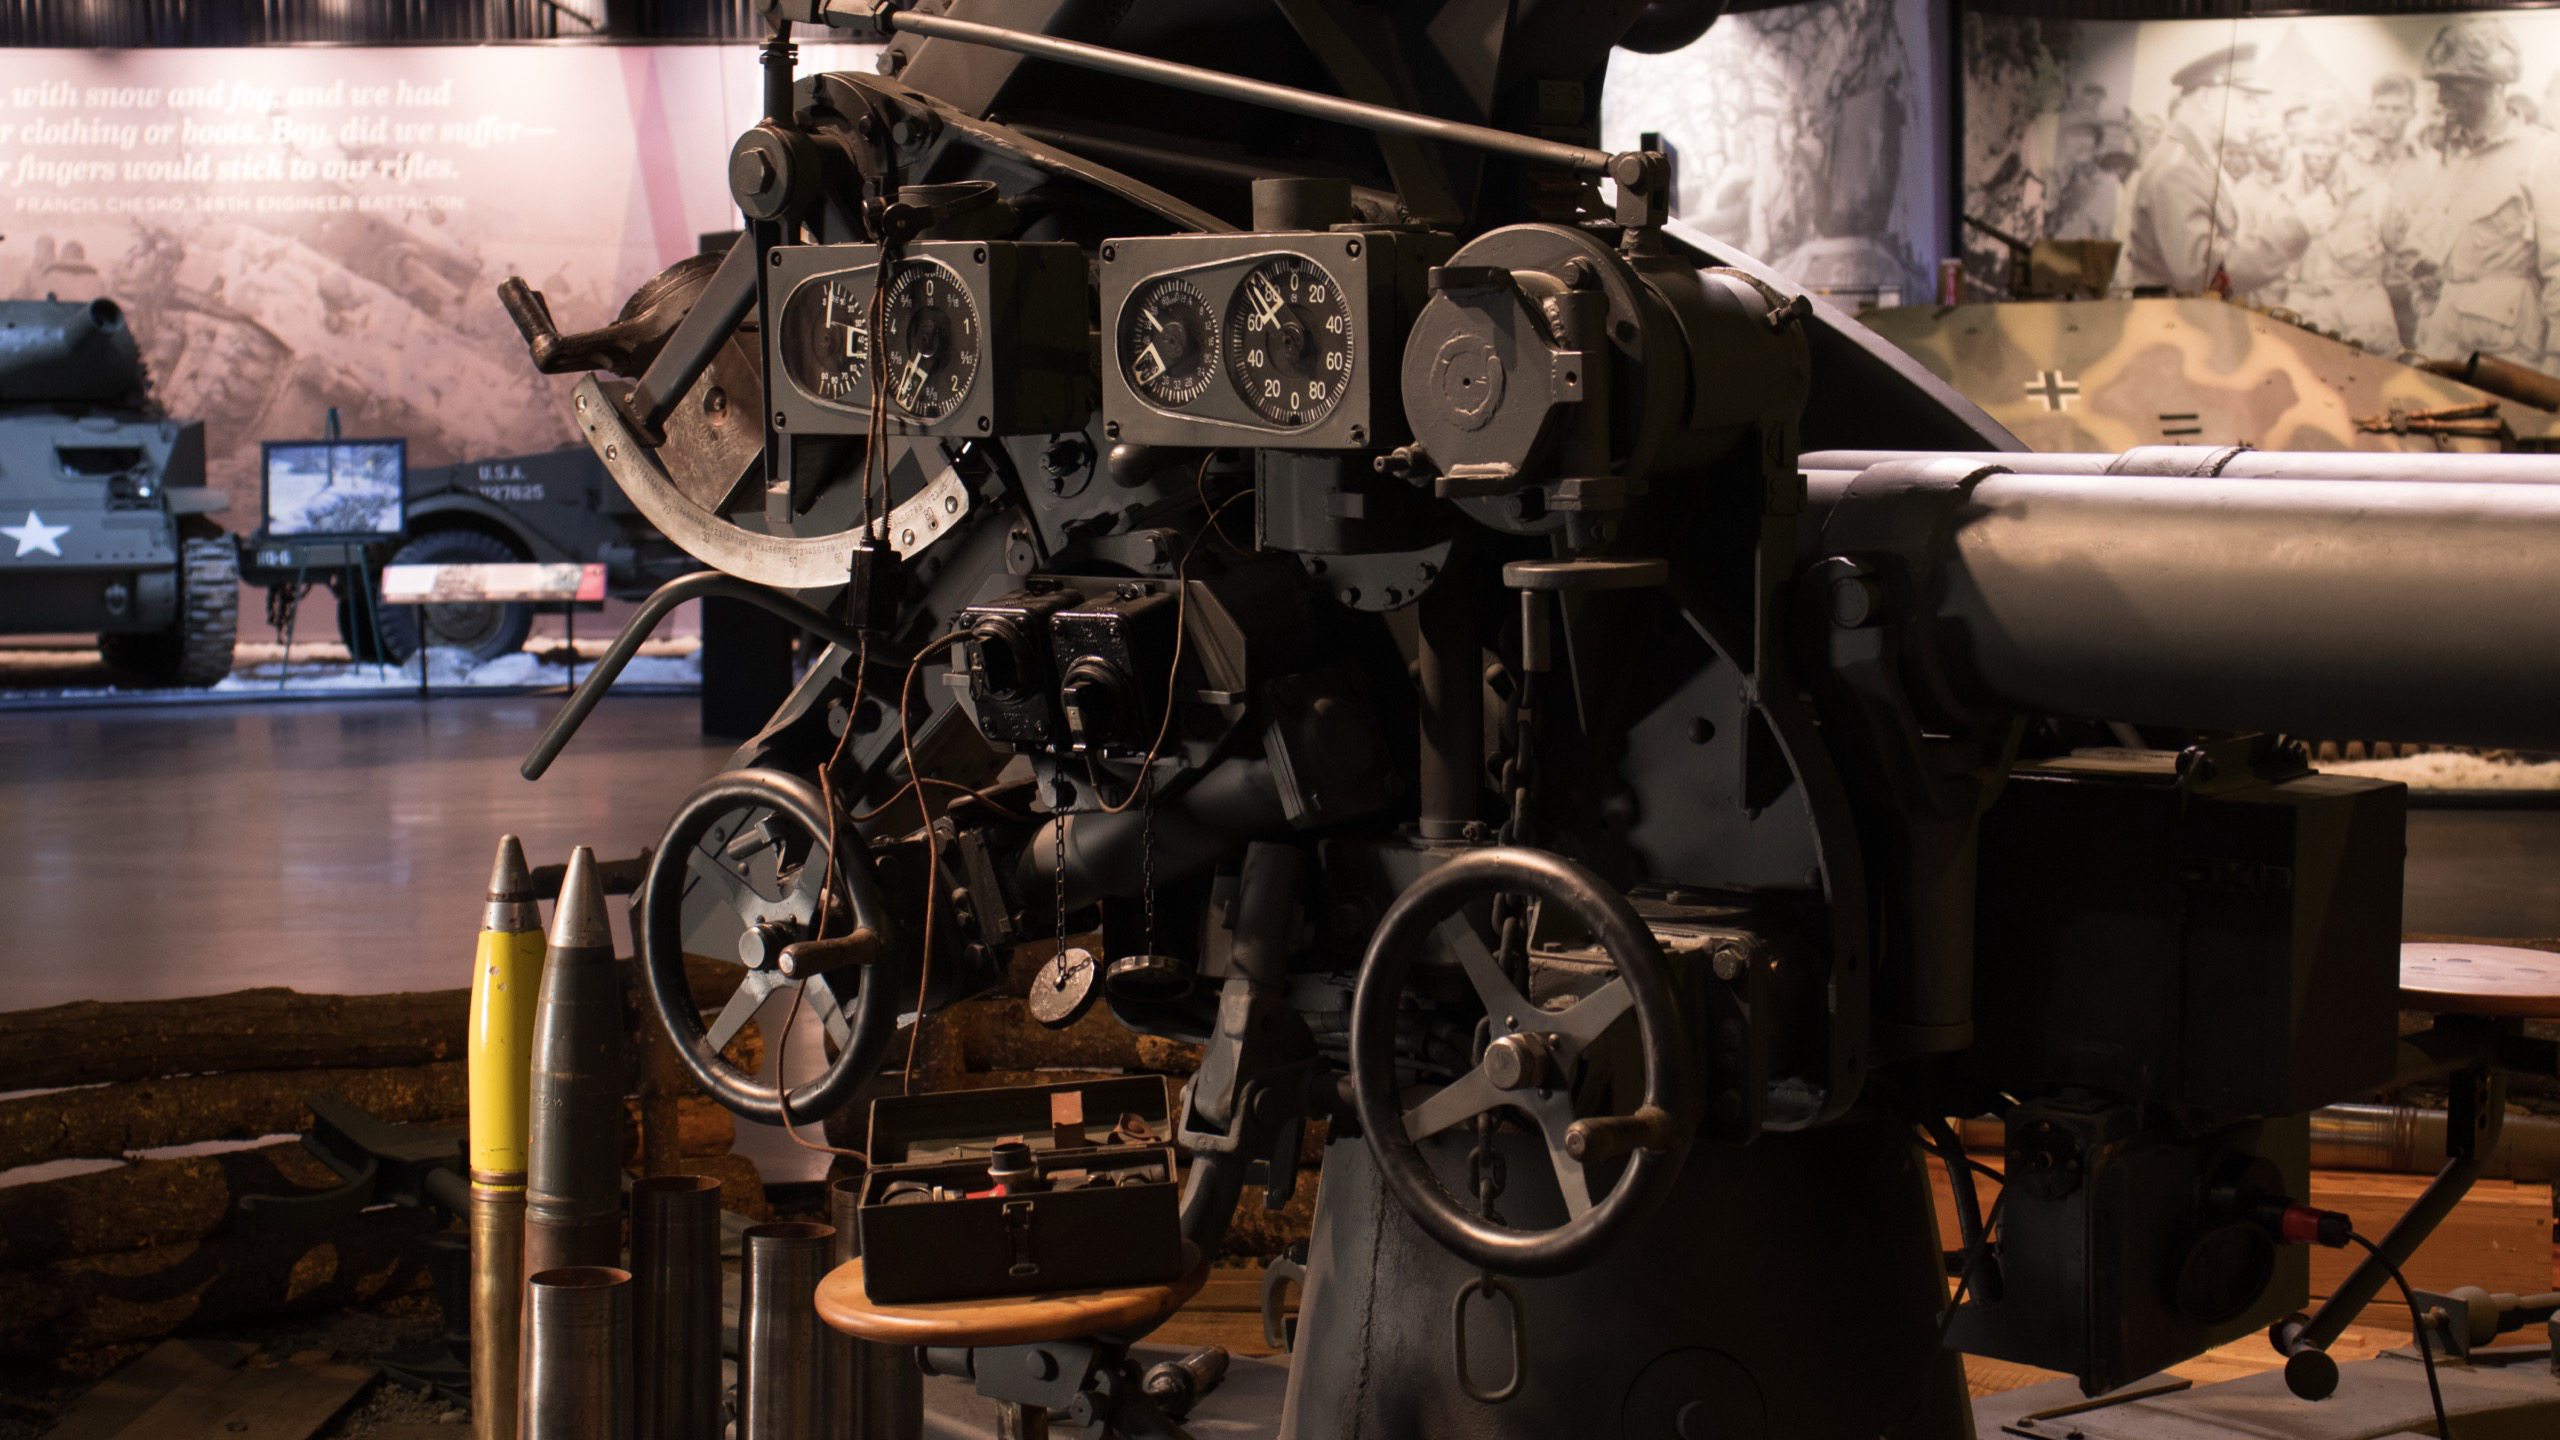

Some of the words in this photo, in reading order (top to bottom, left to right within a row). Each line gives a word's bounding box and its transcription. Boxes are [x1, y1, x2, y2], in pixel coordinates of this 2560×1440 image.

[11, 80, 78, 109] with
[85, 87, 162, 108] snow
[168, 80, 225, 108] and
[287, 80, 344, 108] and
[350, 88, 390, 107] we
[396, 79, 453, 108] had
[20, 117, 138, 151] clothing
[144, 123, 177, 144] or
[339, 115, 389, 144] did
[394, 122, 435, 143] we
[11, 153, 118, 188] fingers
[122, 153, 212, 181] would
[216, 153, 285, 181] stick
[290, 157, 317, 180] to
[321, 160, 375, 181] our
[379, 152, 460, 185] rifles.
[15, 196, 100, 212] FRANCIS
[256, 195, 352, 211] ENGINEER
[358, 195, 466, 211] BATTALION
[926, 280, 934, 296] 0
[1290, 273, 1299, 291] 0
[1309, 285, 1325, 303] 20
[890, 318, 897, 335] 4
[963, 318, 970, 335] 1
[1248, 313, 1264, 332] 60
[1326, 315, 1343, 334] 40
[1248, 349, 1264, 368] 40
[1326, 352, 1343, 370] 60
[951, 375, 958, 392] 2
[1265, 379, 1281, 397] 20
[1309, 381, 1326, 399] 80
[1291, 392, 1299, 410] 0
[478, 465, 526, 480] U.S.A.
